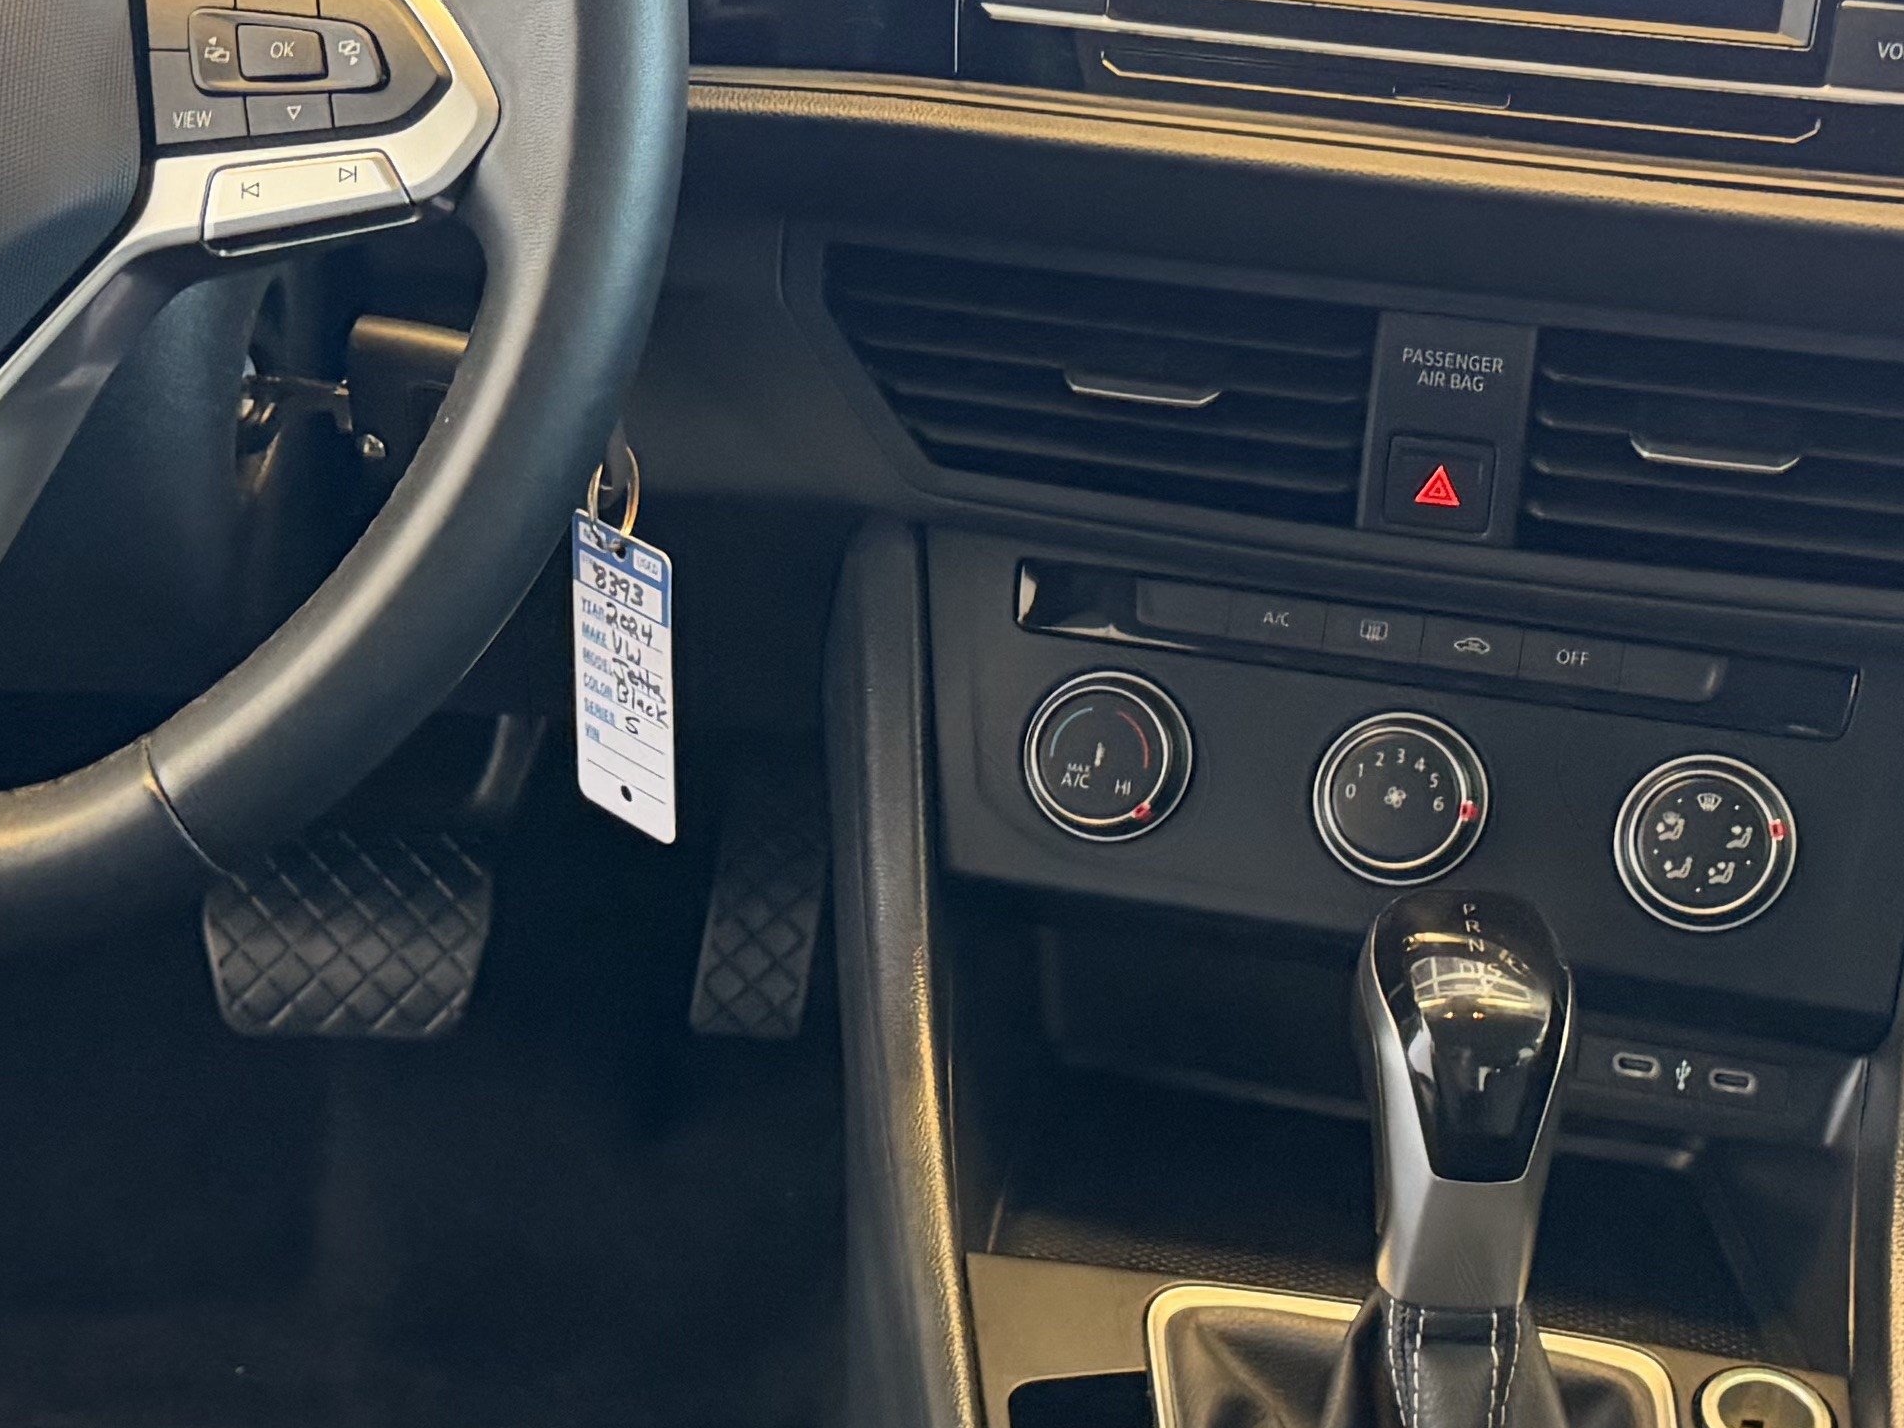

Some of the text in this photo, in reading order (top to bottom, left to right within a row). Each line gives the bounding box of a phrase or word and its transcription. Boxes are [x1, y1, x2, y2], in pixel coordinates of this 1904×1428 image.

[270, 41, 296, 59] OK
[172, 110, 212, 129] VIEW
[1402, 347, 1504, 373] PASSENGER
[1417, 370, 1485, 392] AIR BAG
[592, 562, 645, 607] 8393
[1263, 611, 1290, 627] A/C
[1556, 649, 1590, 667] OFF
[1375, 751, 1385, 767] 2
[1398, 748, 1405, 764] 3
[1358, 763, 1364, 778] 1
[1414, 757, 1426, 772] 4
[1061, 772, 1090, 789] A/C
[1114, 779, 1132, 796] HI
[1429, 772, 1440, 788] 5
[1345, 783, 1357, 799] 0
[1433, 796, 1444, 812] 6
[1463, 903, 1475, 915] P
[1465, 919, 1482, 932] R
[1467, 938, 1485, 952] N
